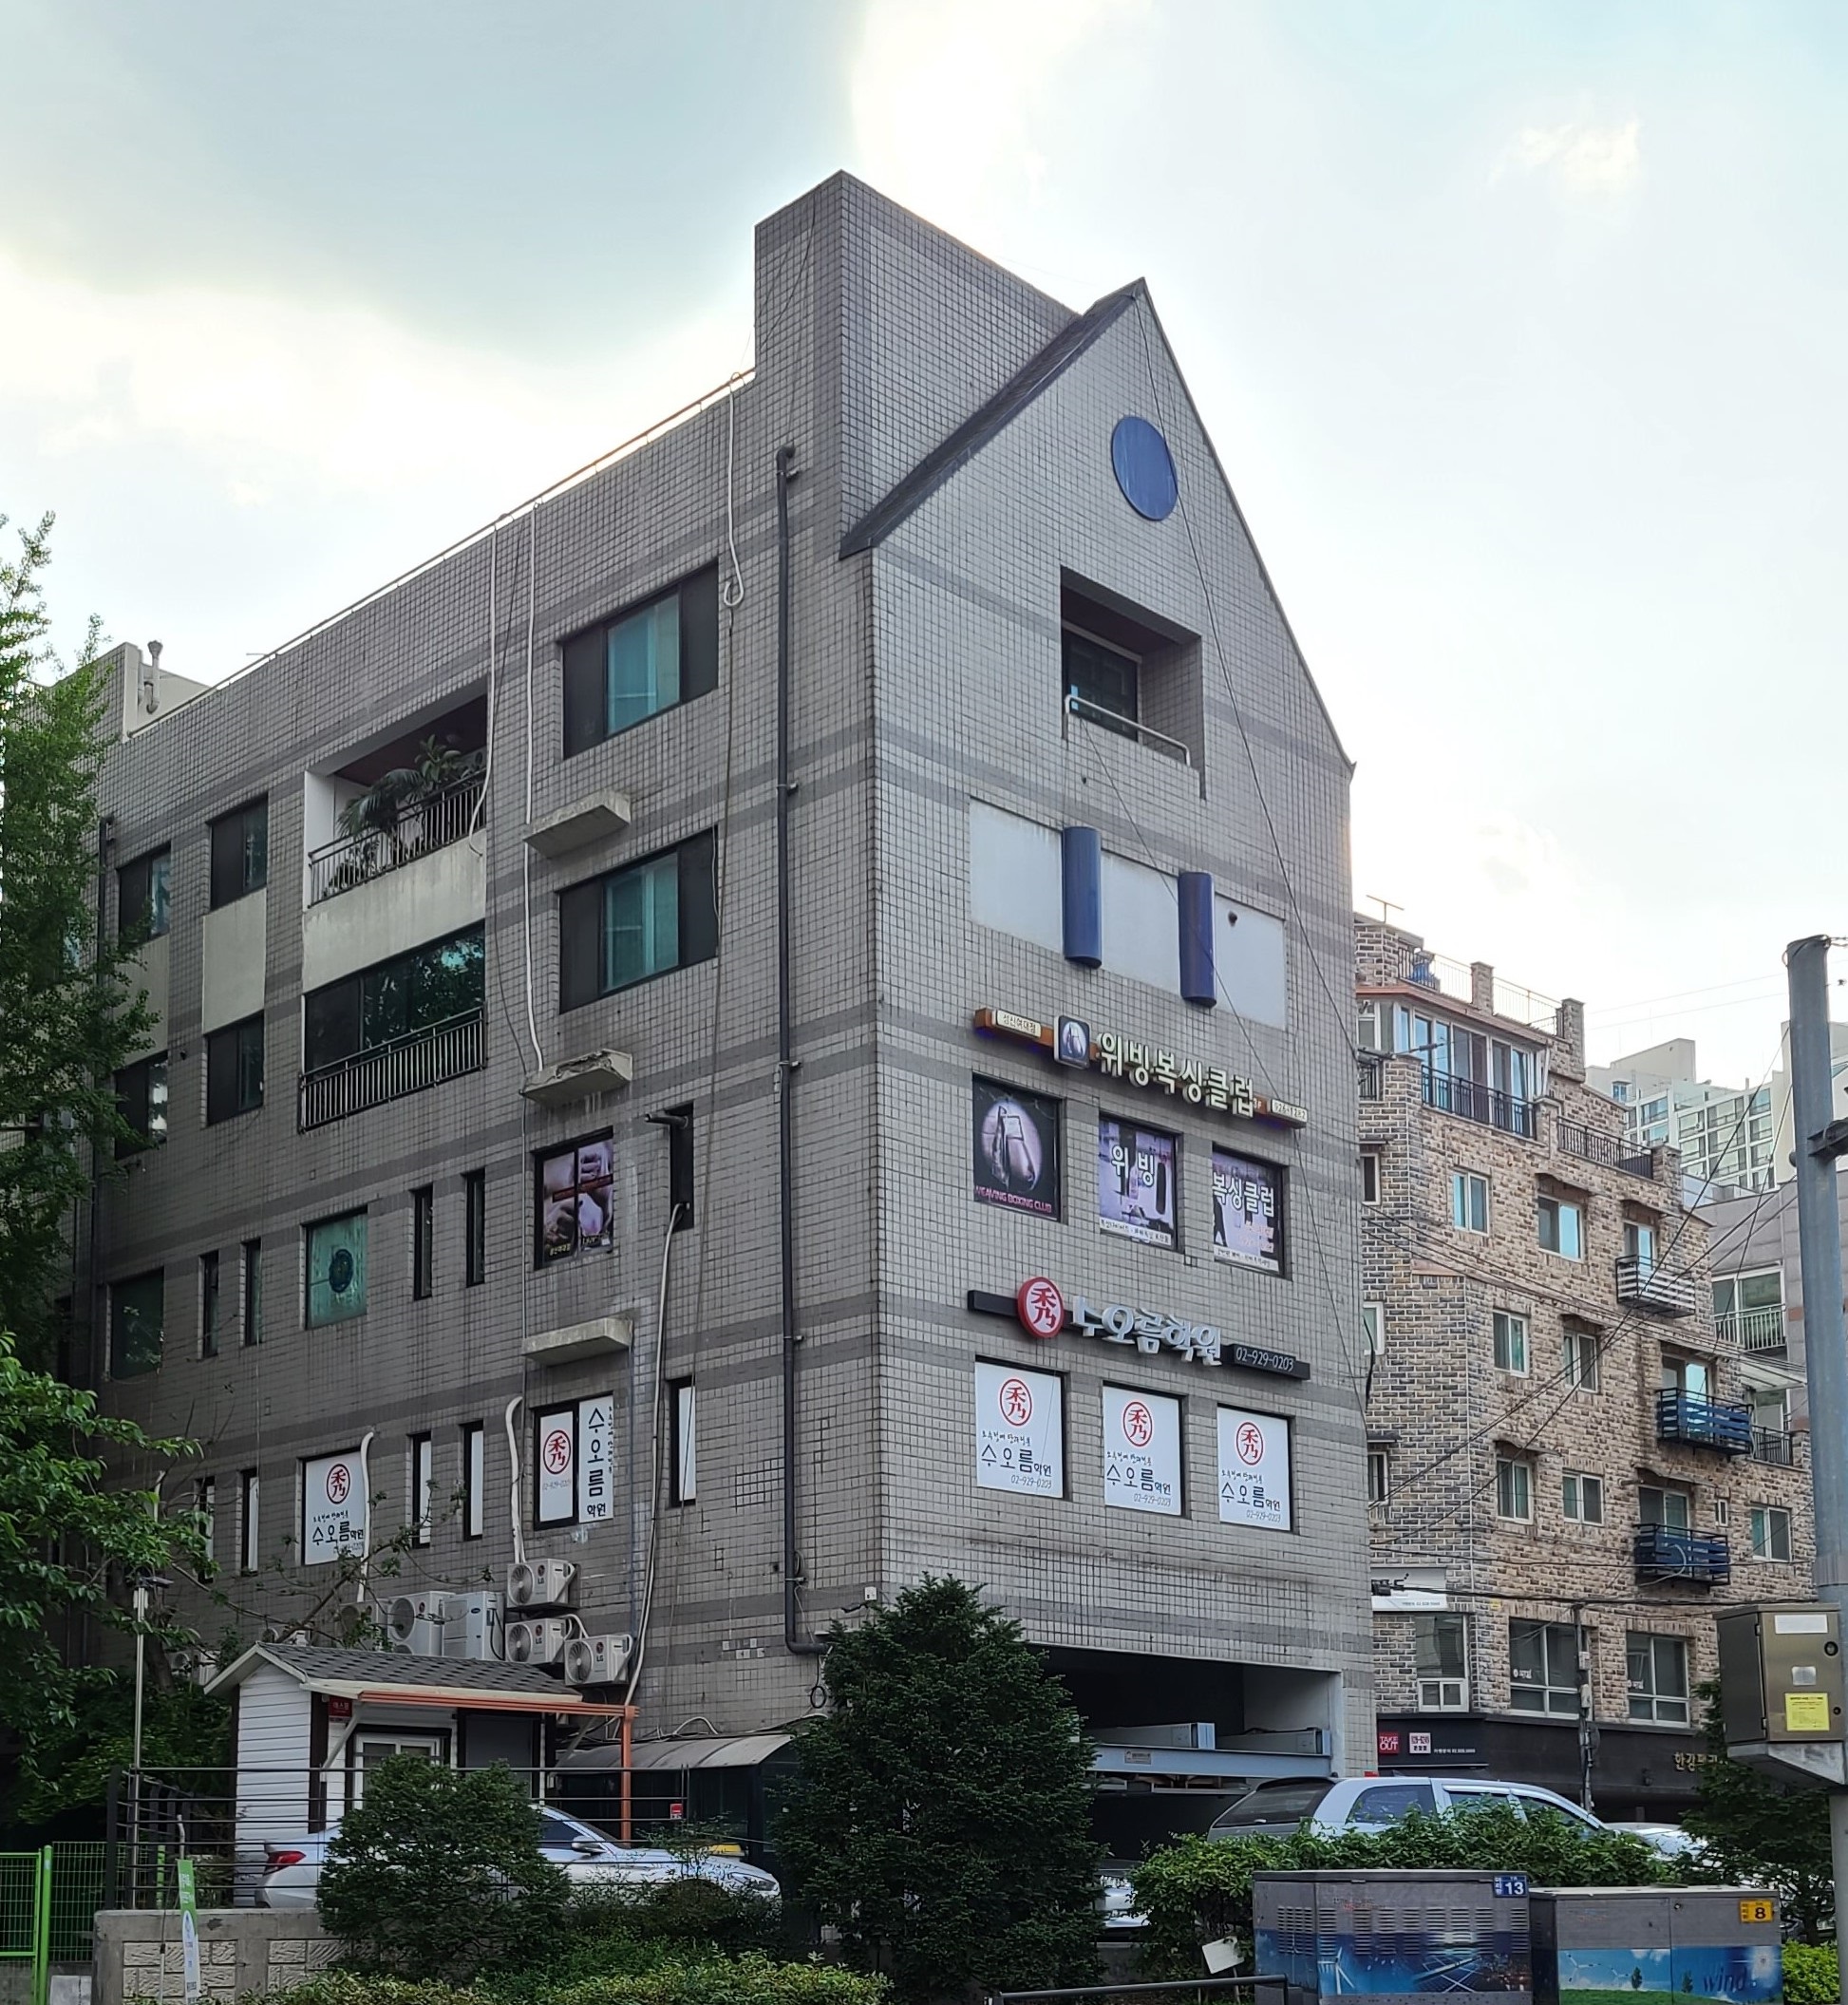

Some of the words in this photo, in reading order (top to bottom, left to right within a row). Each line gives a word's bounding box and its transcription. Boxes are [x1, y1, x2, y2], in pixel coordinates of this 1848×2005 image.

[1098, 1032, 1254, 1118] 위빙복싱클럽
[1008, 1192, 1033, 1208] BOXING
[1034, 1200, 1052, 1213] CLUB
[1213, 1172, 1275, 1218] 복싱클럽
[1031, 1287, 1057, 1329] 秀
[1072, 1296, 1222, 1366] 수오름학원
[1235, 1347, 1294, 1371] 02-929-0203
[1006, 1387, 1027, 1419] 秀
[1128, 1409, 1148, 1440] 秀
[548, 1435, 566, 1467] 秀
[587, 1407, 605, 1497] 수오름
[1241, 1429, 1258, 1459] 秀
[330, 1468, 347, 1498] 秀
[1010, 1474, 1052, 1489] 02-929-0203
[1134, 1493, 1171, 1507] 02-929-0203
[1246, 1510, 1281, 1523] 02-929-0203
[1380, 1741, 1398, 1750] OUT
[1505, 1882, 1524, 1895] 13
[1755, 1906, 1766, 1920] 8
